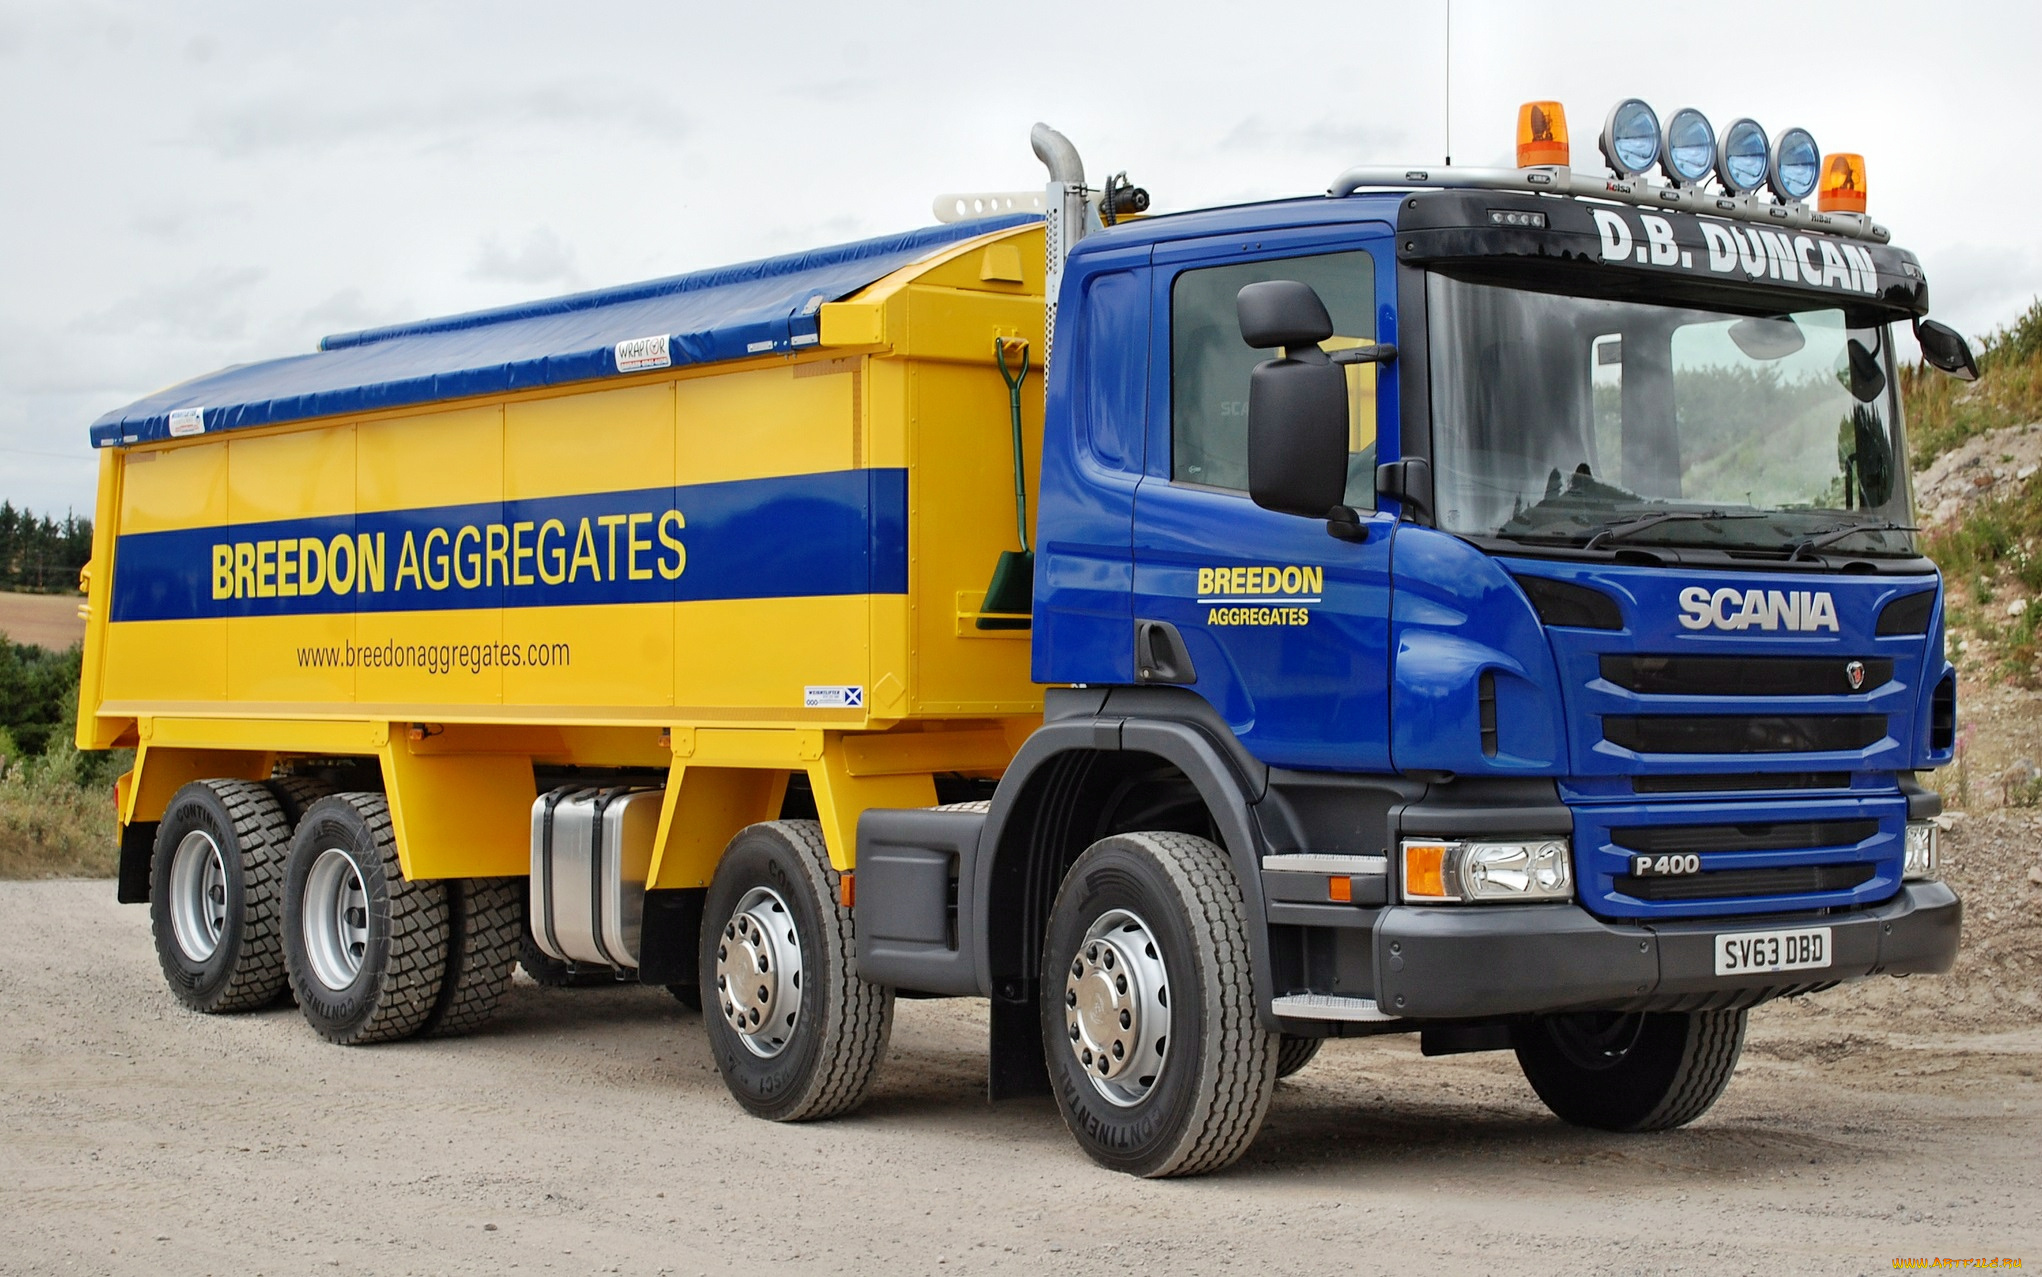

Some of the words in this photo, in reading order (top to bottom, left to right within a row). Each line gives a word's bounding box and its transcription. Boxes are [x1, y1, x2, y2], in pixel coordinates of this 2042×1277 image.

[1593, 208, 1693, 269] D.B.
[1699, 221, 1878, 295] DUNCAN
[212, 532, 385, 600] BREEDON
[394, 509, 687, 592] AGGREGATES
[1197, 566, 1323, 595] BREEDON
[1207, 607, 1309, 626] AGGREGATES
[1678, 586, 1840, 632] SCANIA
[297, 639, 570, 674] www.breedonaggregates.com
[1654, 854, 1700, 875] 400
[1725, 937, 1779, 969] SV63
[1785, 934, 1823, 964] DBD
